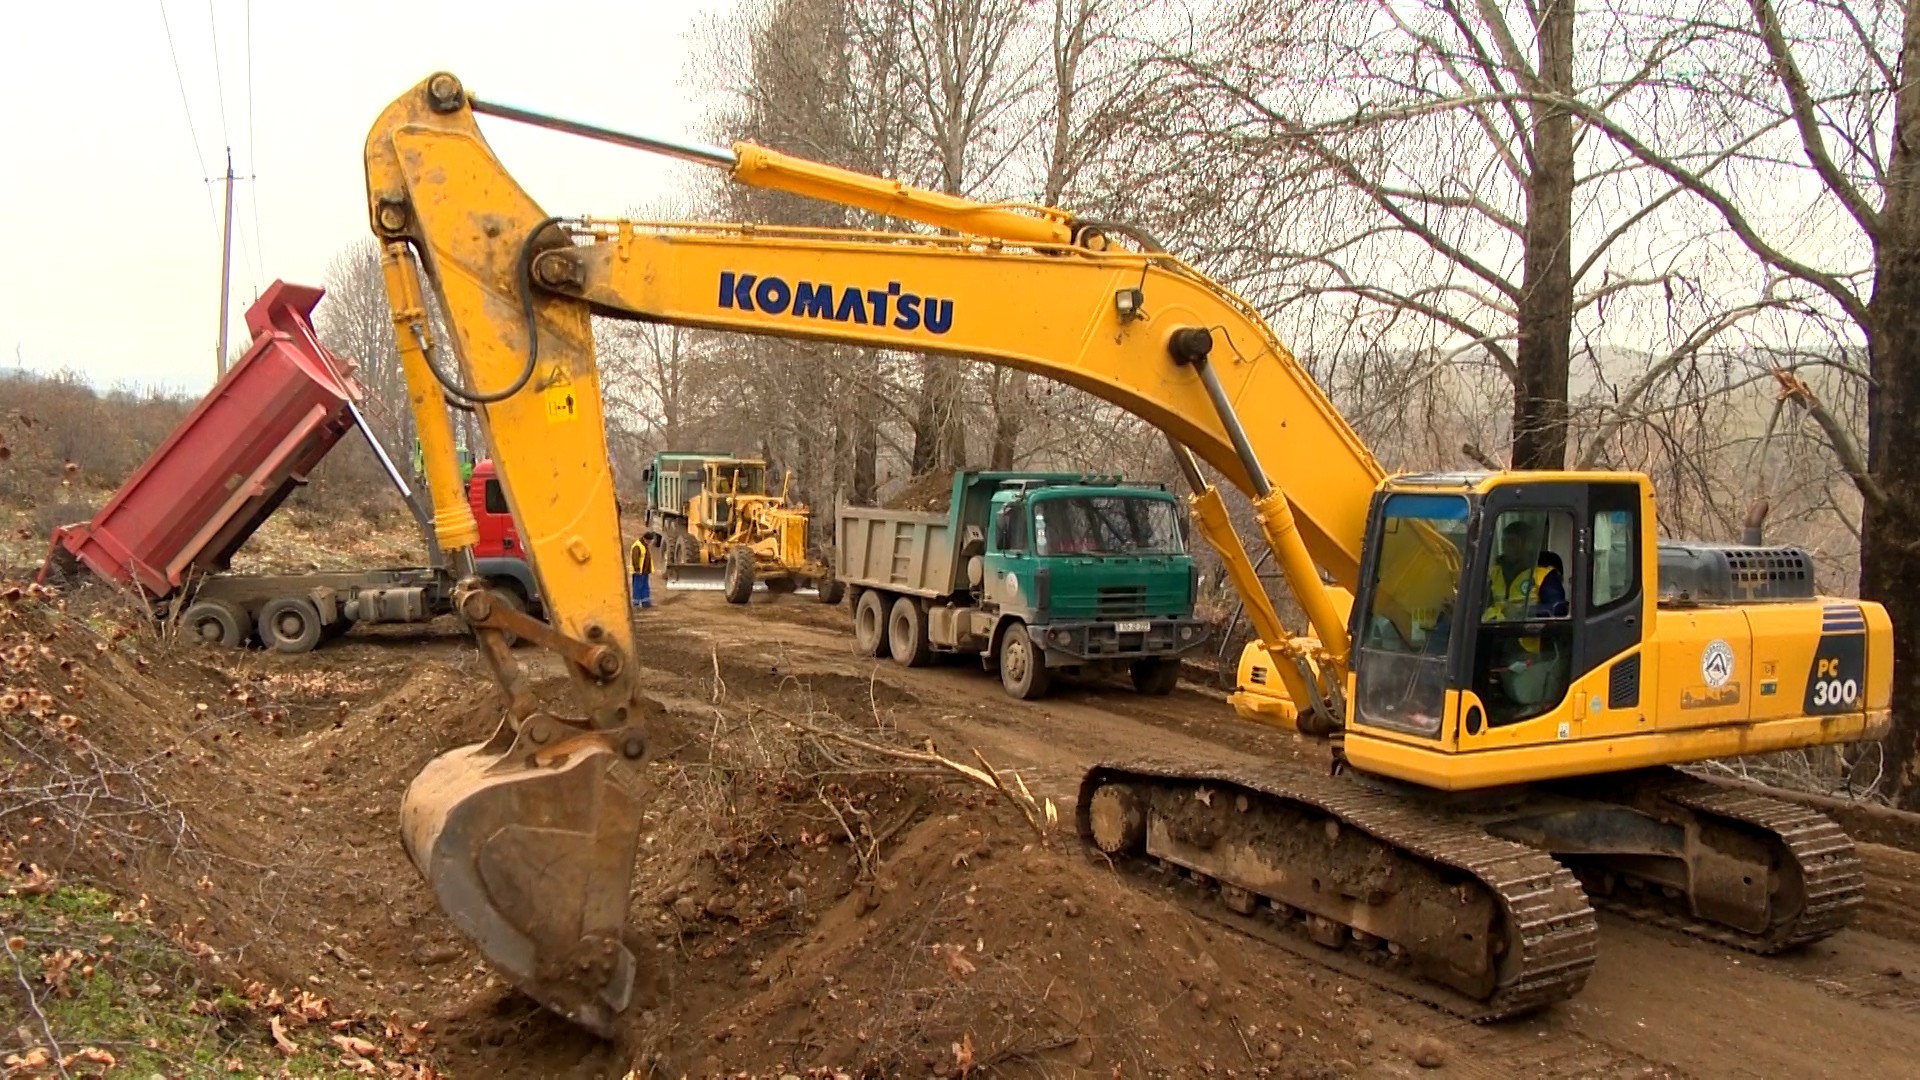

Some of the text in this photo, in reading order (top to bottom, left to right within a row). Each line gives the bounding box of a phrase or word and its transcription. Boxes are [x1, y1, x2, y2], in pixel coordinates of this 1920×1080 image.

[719, 271, 953, 334] KOMATSU
[1817, 658, 1839, 678] PC
[1813, 679, 1857, 706] 300
